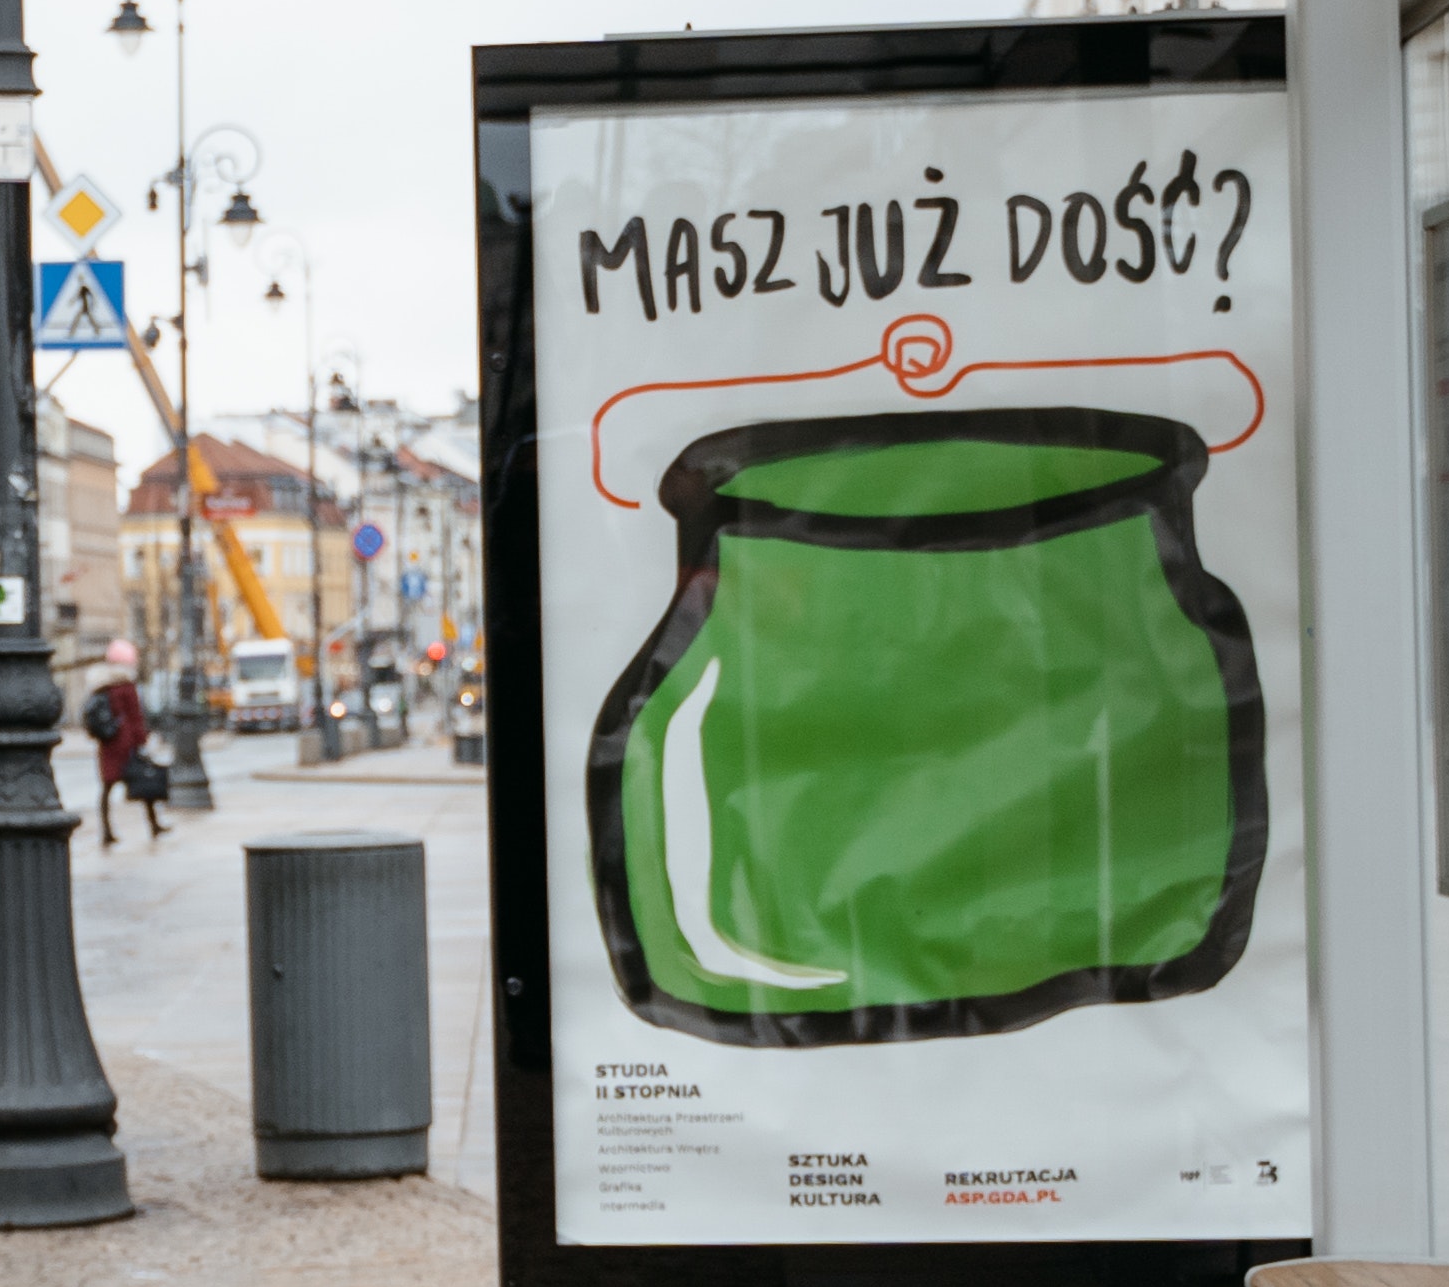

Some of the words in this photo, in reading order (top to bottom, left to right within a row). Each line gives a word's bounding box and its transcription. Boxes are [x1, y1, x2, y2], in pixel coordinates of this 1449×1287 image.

[579, 208, 796, 321] MASZ
[815, 165, 971, 308] JUŻ
[1007, 148, 1254, 314] DOŚĆ?
[596, 1063, 668, 1078] STUDIA
[596, 1085, 608, 1099] II
[614, 1084, 701, 1100] STOPNIA
[788, 1153, 869, 1167] SZTUKA
[789, 1173, 863, 1187] DESIGN
[945, 1168, 1078, 1187] REKRUTACJA
[790, 1192, 881, 1206] KULTURA
[945, 1189, 1062, 1205] ASP.GDA.PL
